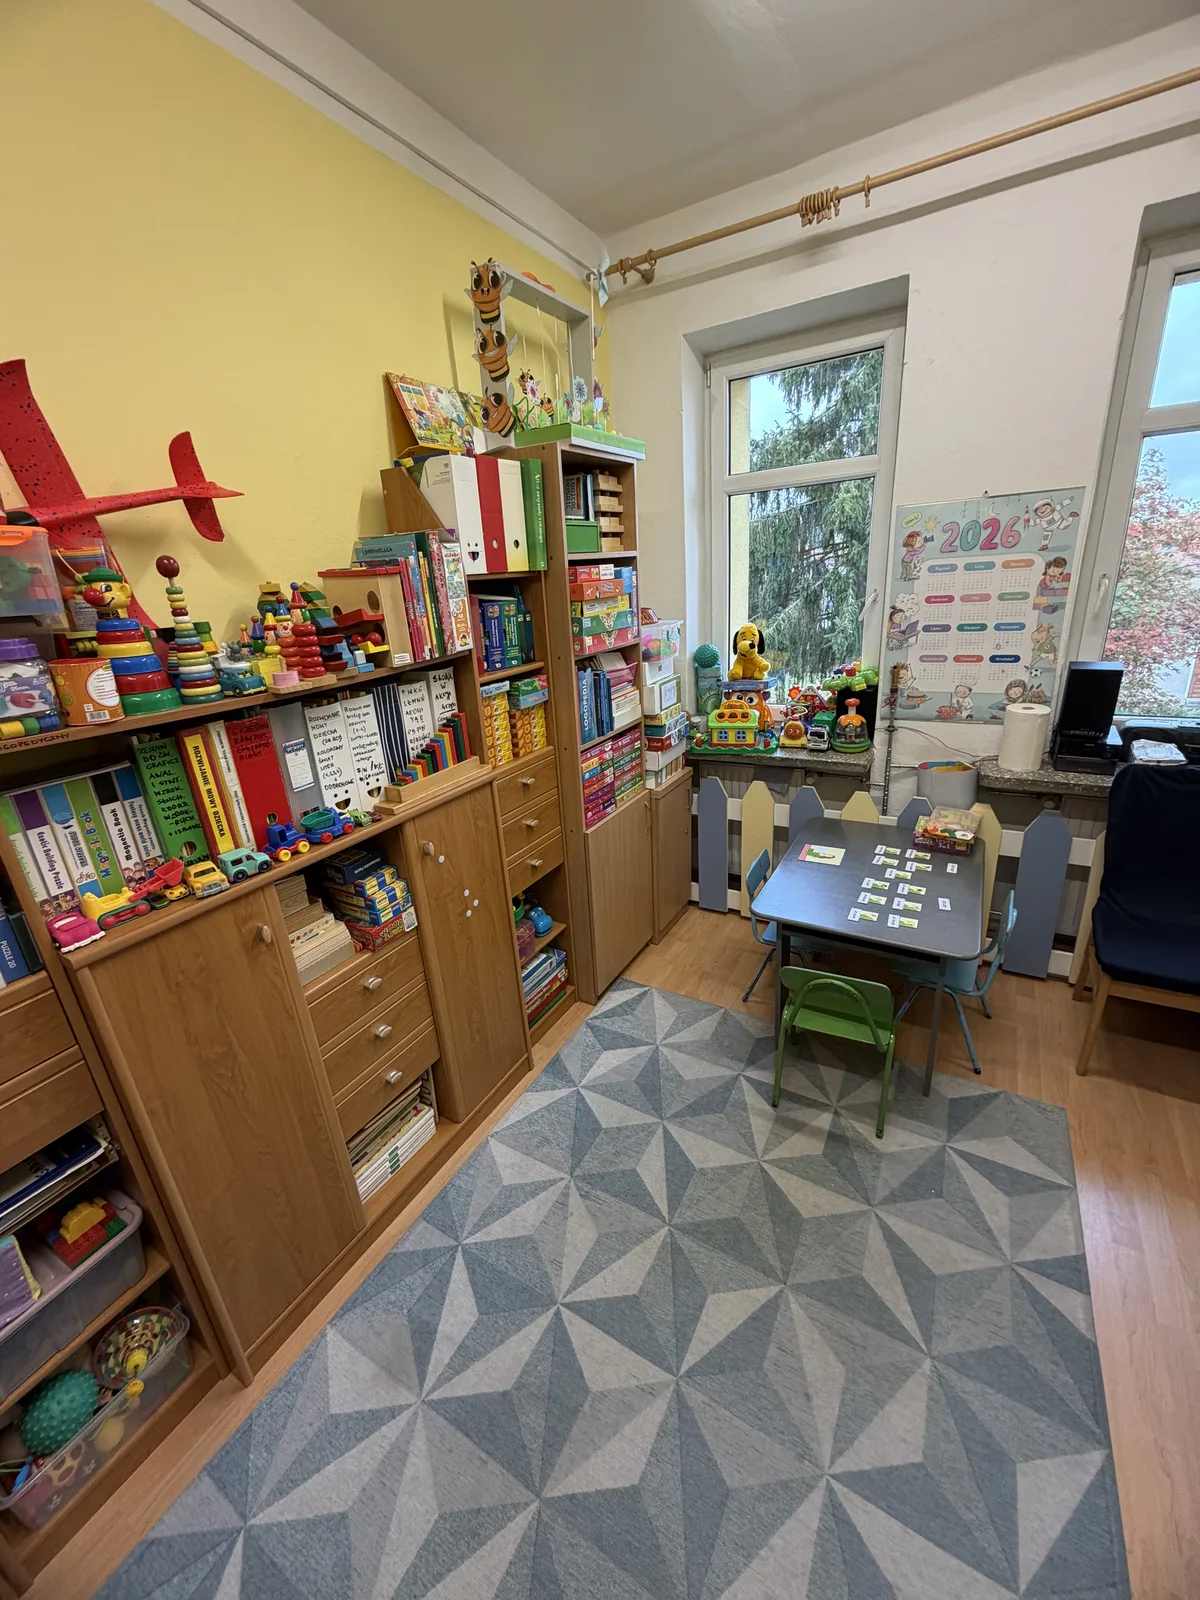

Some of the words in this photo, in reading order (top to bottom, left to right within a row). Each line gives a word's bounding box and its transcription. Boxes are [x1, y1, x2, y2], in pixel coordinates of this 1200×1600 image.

[940, 516, 1021, 553] 2026
[142, 754, 156, 762] DO
[192, 745, 211, 786] ROZWIJANIE
[206, 788, 218, 807] MOWY
[212, 807, 225, 838] DZIECKA
[80, 810, 94, 836] Book
[110, 807, 121, 828] Book
[36, 831, 49, 855] Exotic
[42, 852, 59, 879] Building
[51, 872, 64, 890] Puzzle
[0, 940, 14, 961] PUZZLE
[8, 960, 17, 969] 20
